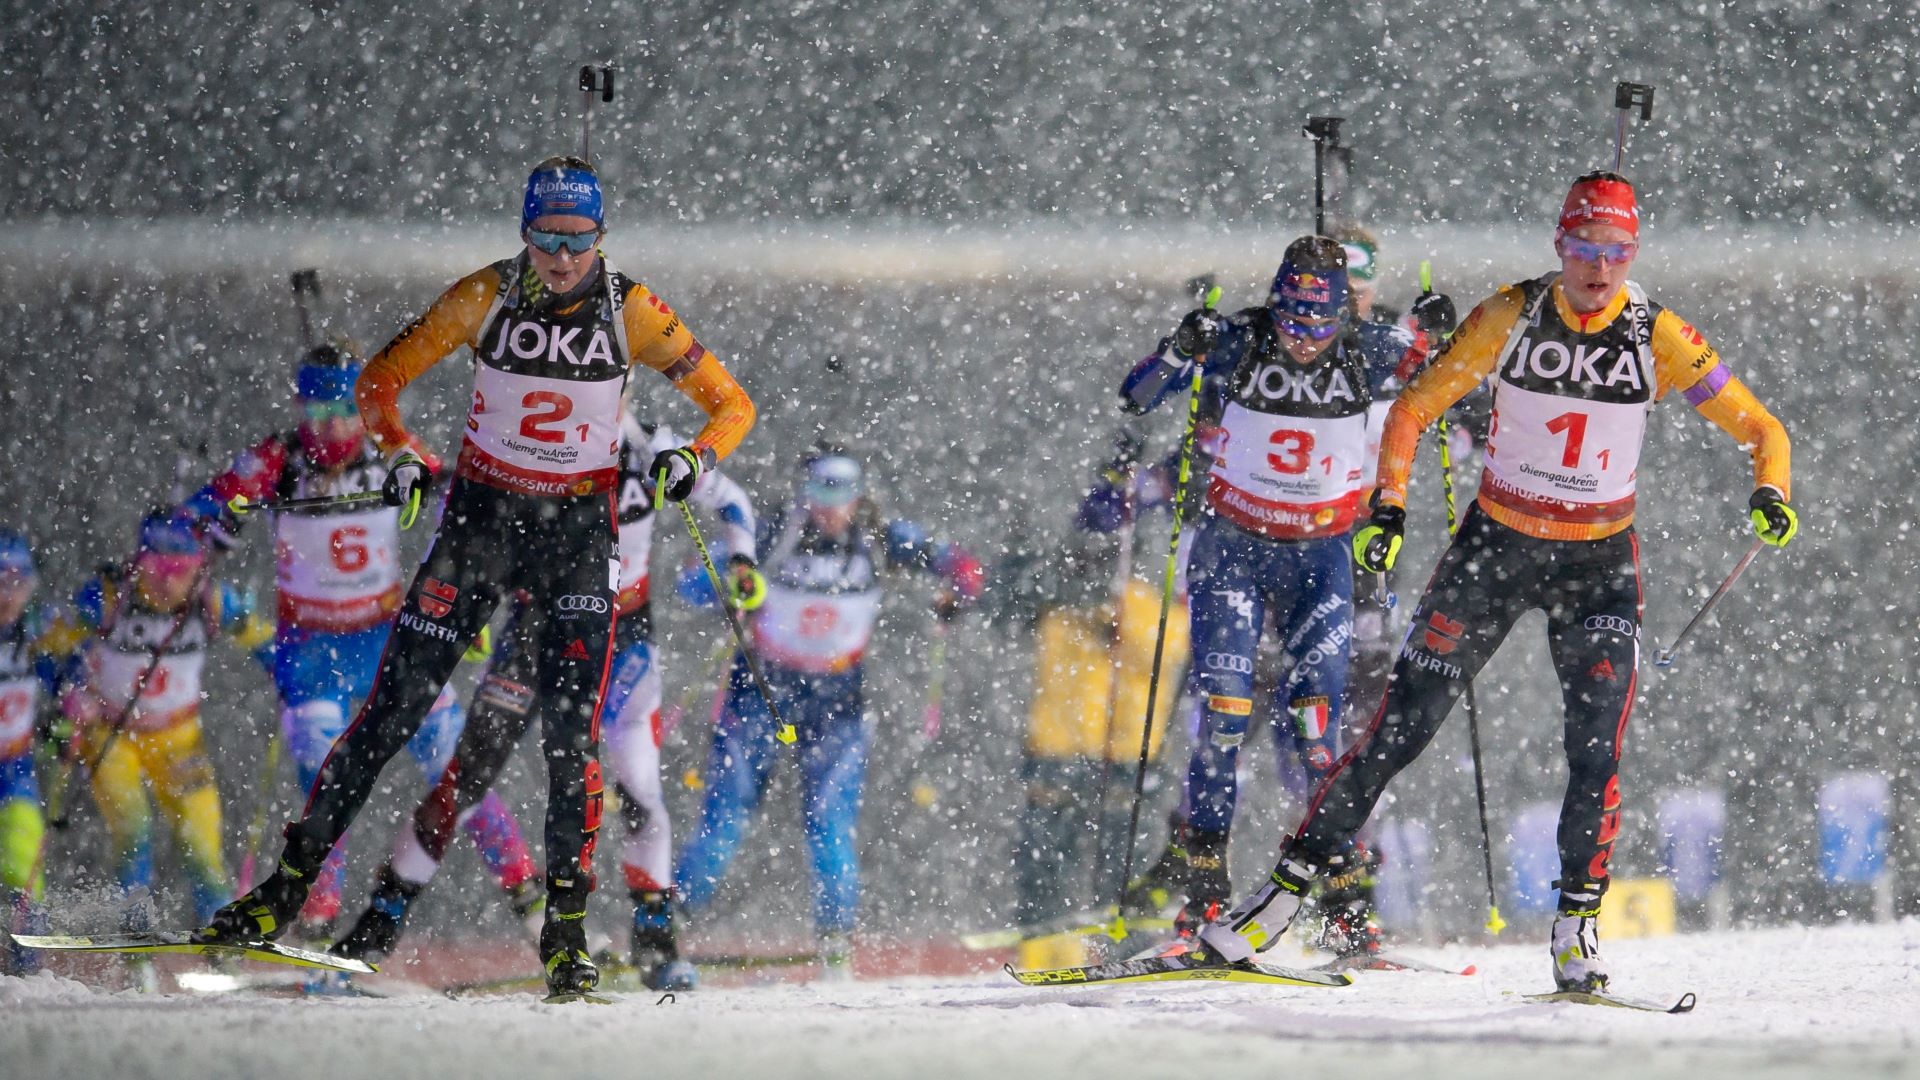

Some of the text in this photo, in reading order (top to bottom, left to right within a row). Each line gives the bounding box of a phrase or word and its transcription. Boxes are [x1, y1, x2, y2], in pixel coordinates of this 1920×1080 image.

[491, 320, 615, 366] JOKA
[1632, 303, 1652, 347] JOKA
[1241, 361, 1356, 404] JOKA
[1510, 336, 1642, 391] JOKA
[519, 390, 574, 444] 2
[576, 423, 590, 443] 1
[1267, 428, 1315, 475] 3
[1545, 411, 1589, 469] 1
[1597, 448, 1611, 471] 1
[1319, 455, 1334, 476] 1
[329, 526, 370, 574] 6
[1585, 632, 1606, 641] Adi
